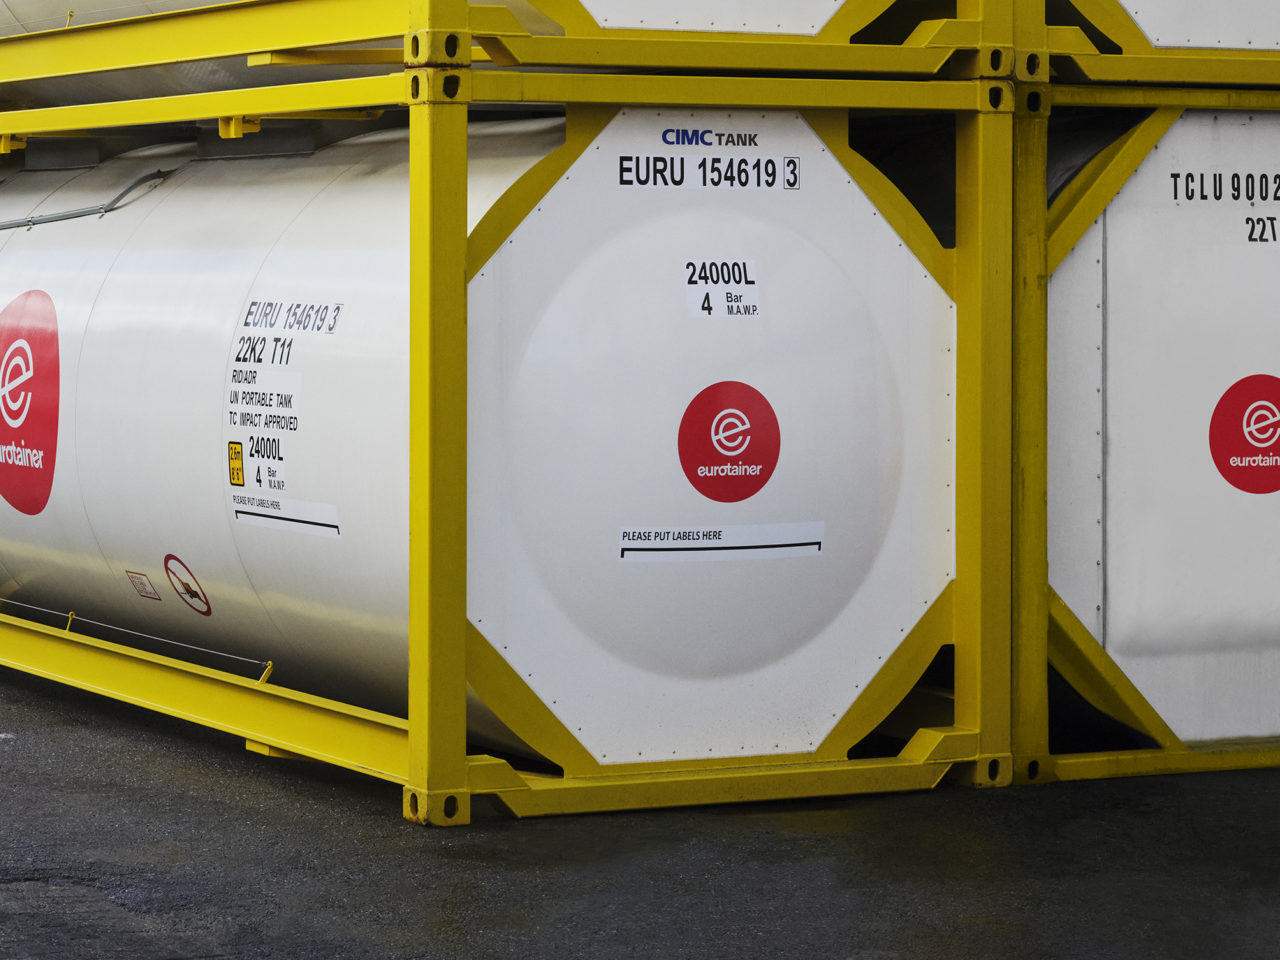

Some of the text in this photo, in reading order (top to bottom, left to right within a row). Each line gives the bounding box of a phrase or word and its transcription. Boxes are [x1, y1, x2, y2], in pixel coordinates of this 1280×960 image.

[661, 128, 759, 147] CIMC TANK
[619, 156, 798, 188] EURU 154619 3
[1170, 172, 1280, 201] TCLU 9002
[1245, 216, 1277, 243] 22T
[686, 262, 756, 285] 24000L
[701, 292, 743, 316] 4 Bar
[727, 305, 759, 316] M.A.W.P.
[243, 301, 341, 332] EURU 154619 3
[235, 336, 294, 365] 22K2 T11
[229, 390, 293, 409] UN PORTABLE TANK
[229, 411, 298, 431] TC IMPACT APPROVED
[249, 436, 284, 461] 24000L
[1229, 452, 1280, 467] eurotain
[255, 466, 277, 488] 4 Bar
[697, 460, 763, 477] eurotainer
[232, 495, 281, 511] PLEASE PUT LABELS HERE
[622, 530, 723, 541] PLEASE PUT LABELS HERE
